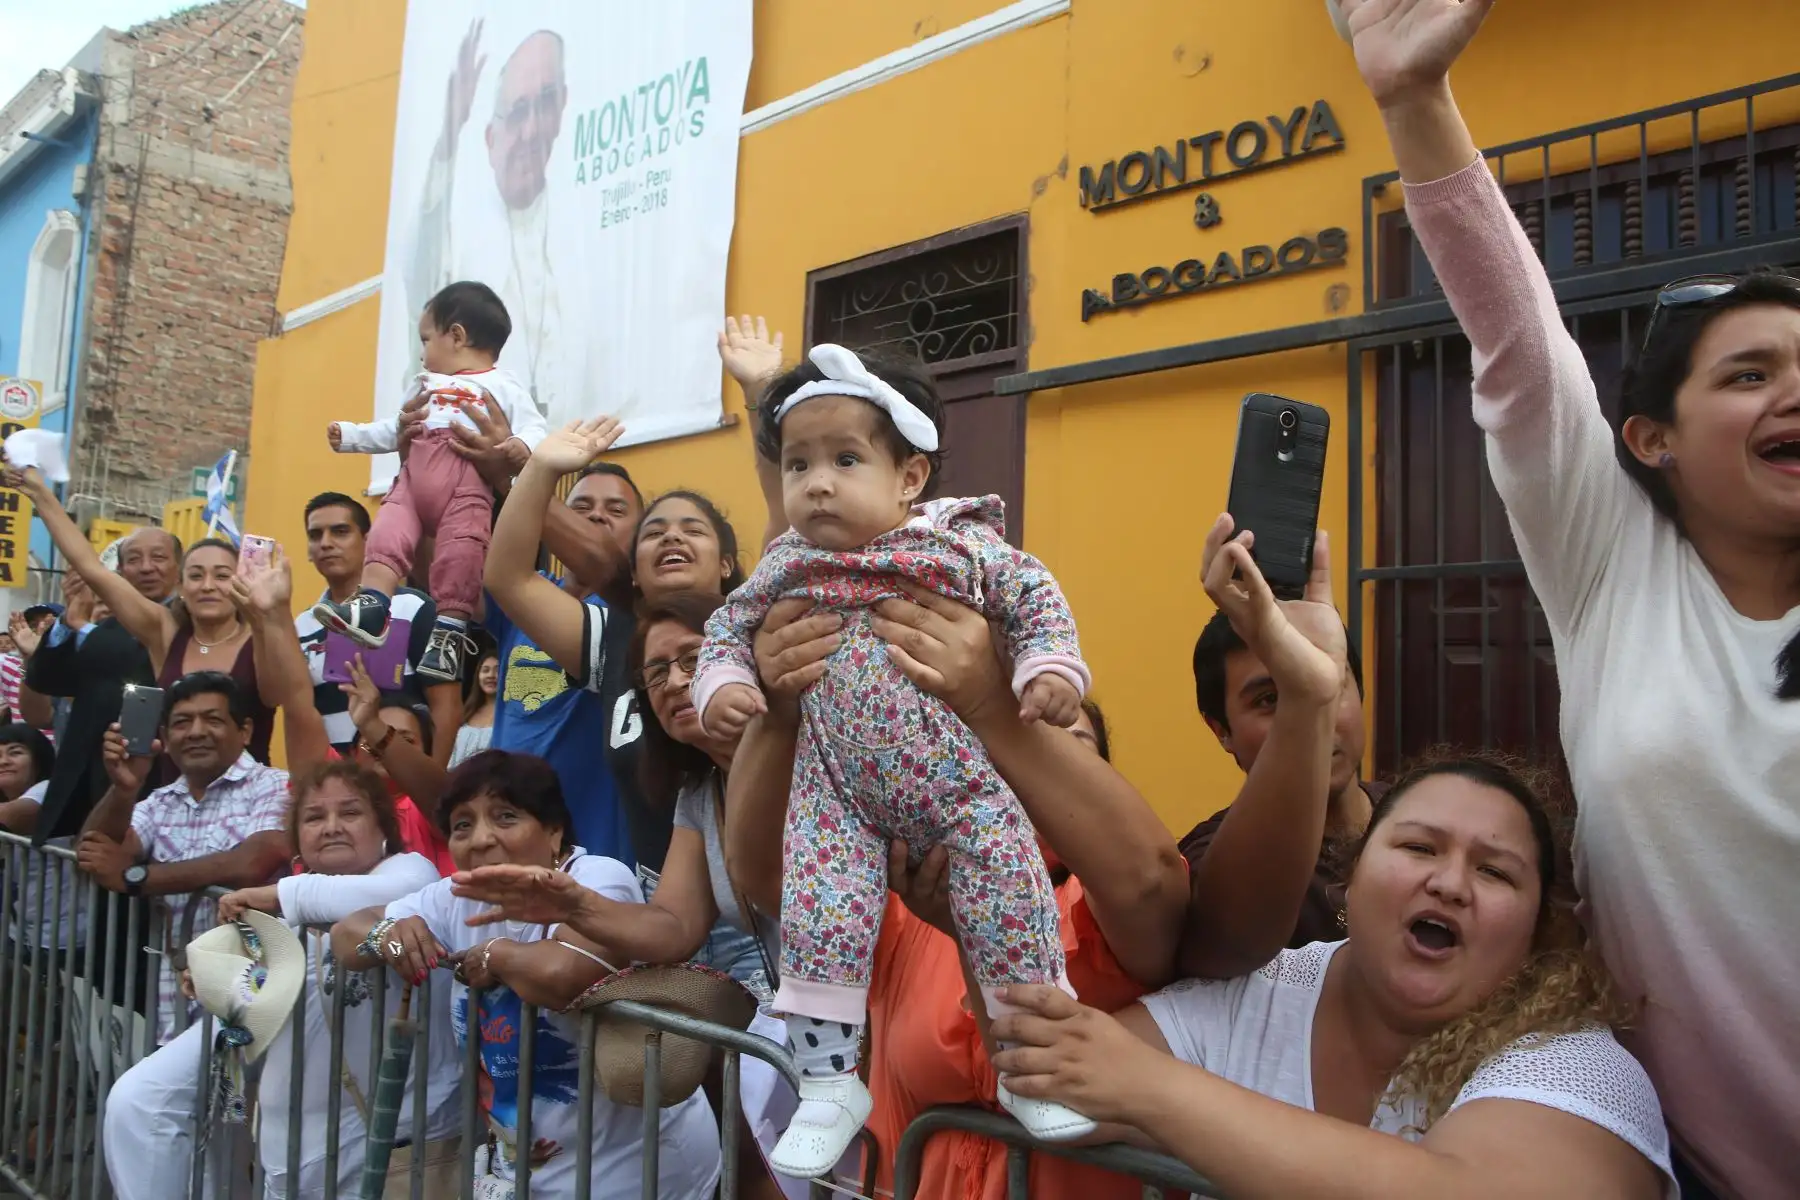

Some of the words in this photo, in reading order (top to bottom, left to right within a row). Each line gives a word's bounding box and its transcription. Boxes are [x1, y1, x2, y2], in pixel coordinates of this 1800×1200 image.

[574, 56, 711, 161] MONTOYA
[575, 109, 705, 186] ABOGADOS
[1079, 98, 1345, 208] MONTOYA
[601, 206, 631, 229] Enero
[641, 188, 668, 213] 2018
[1193, 192, 1223, 230] &
[1082, 226, 1349, 323] ABOGADOS
